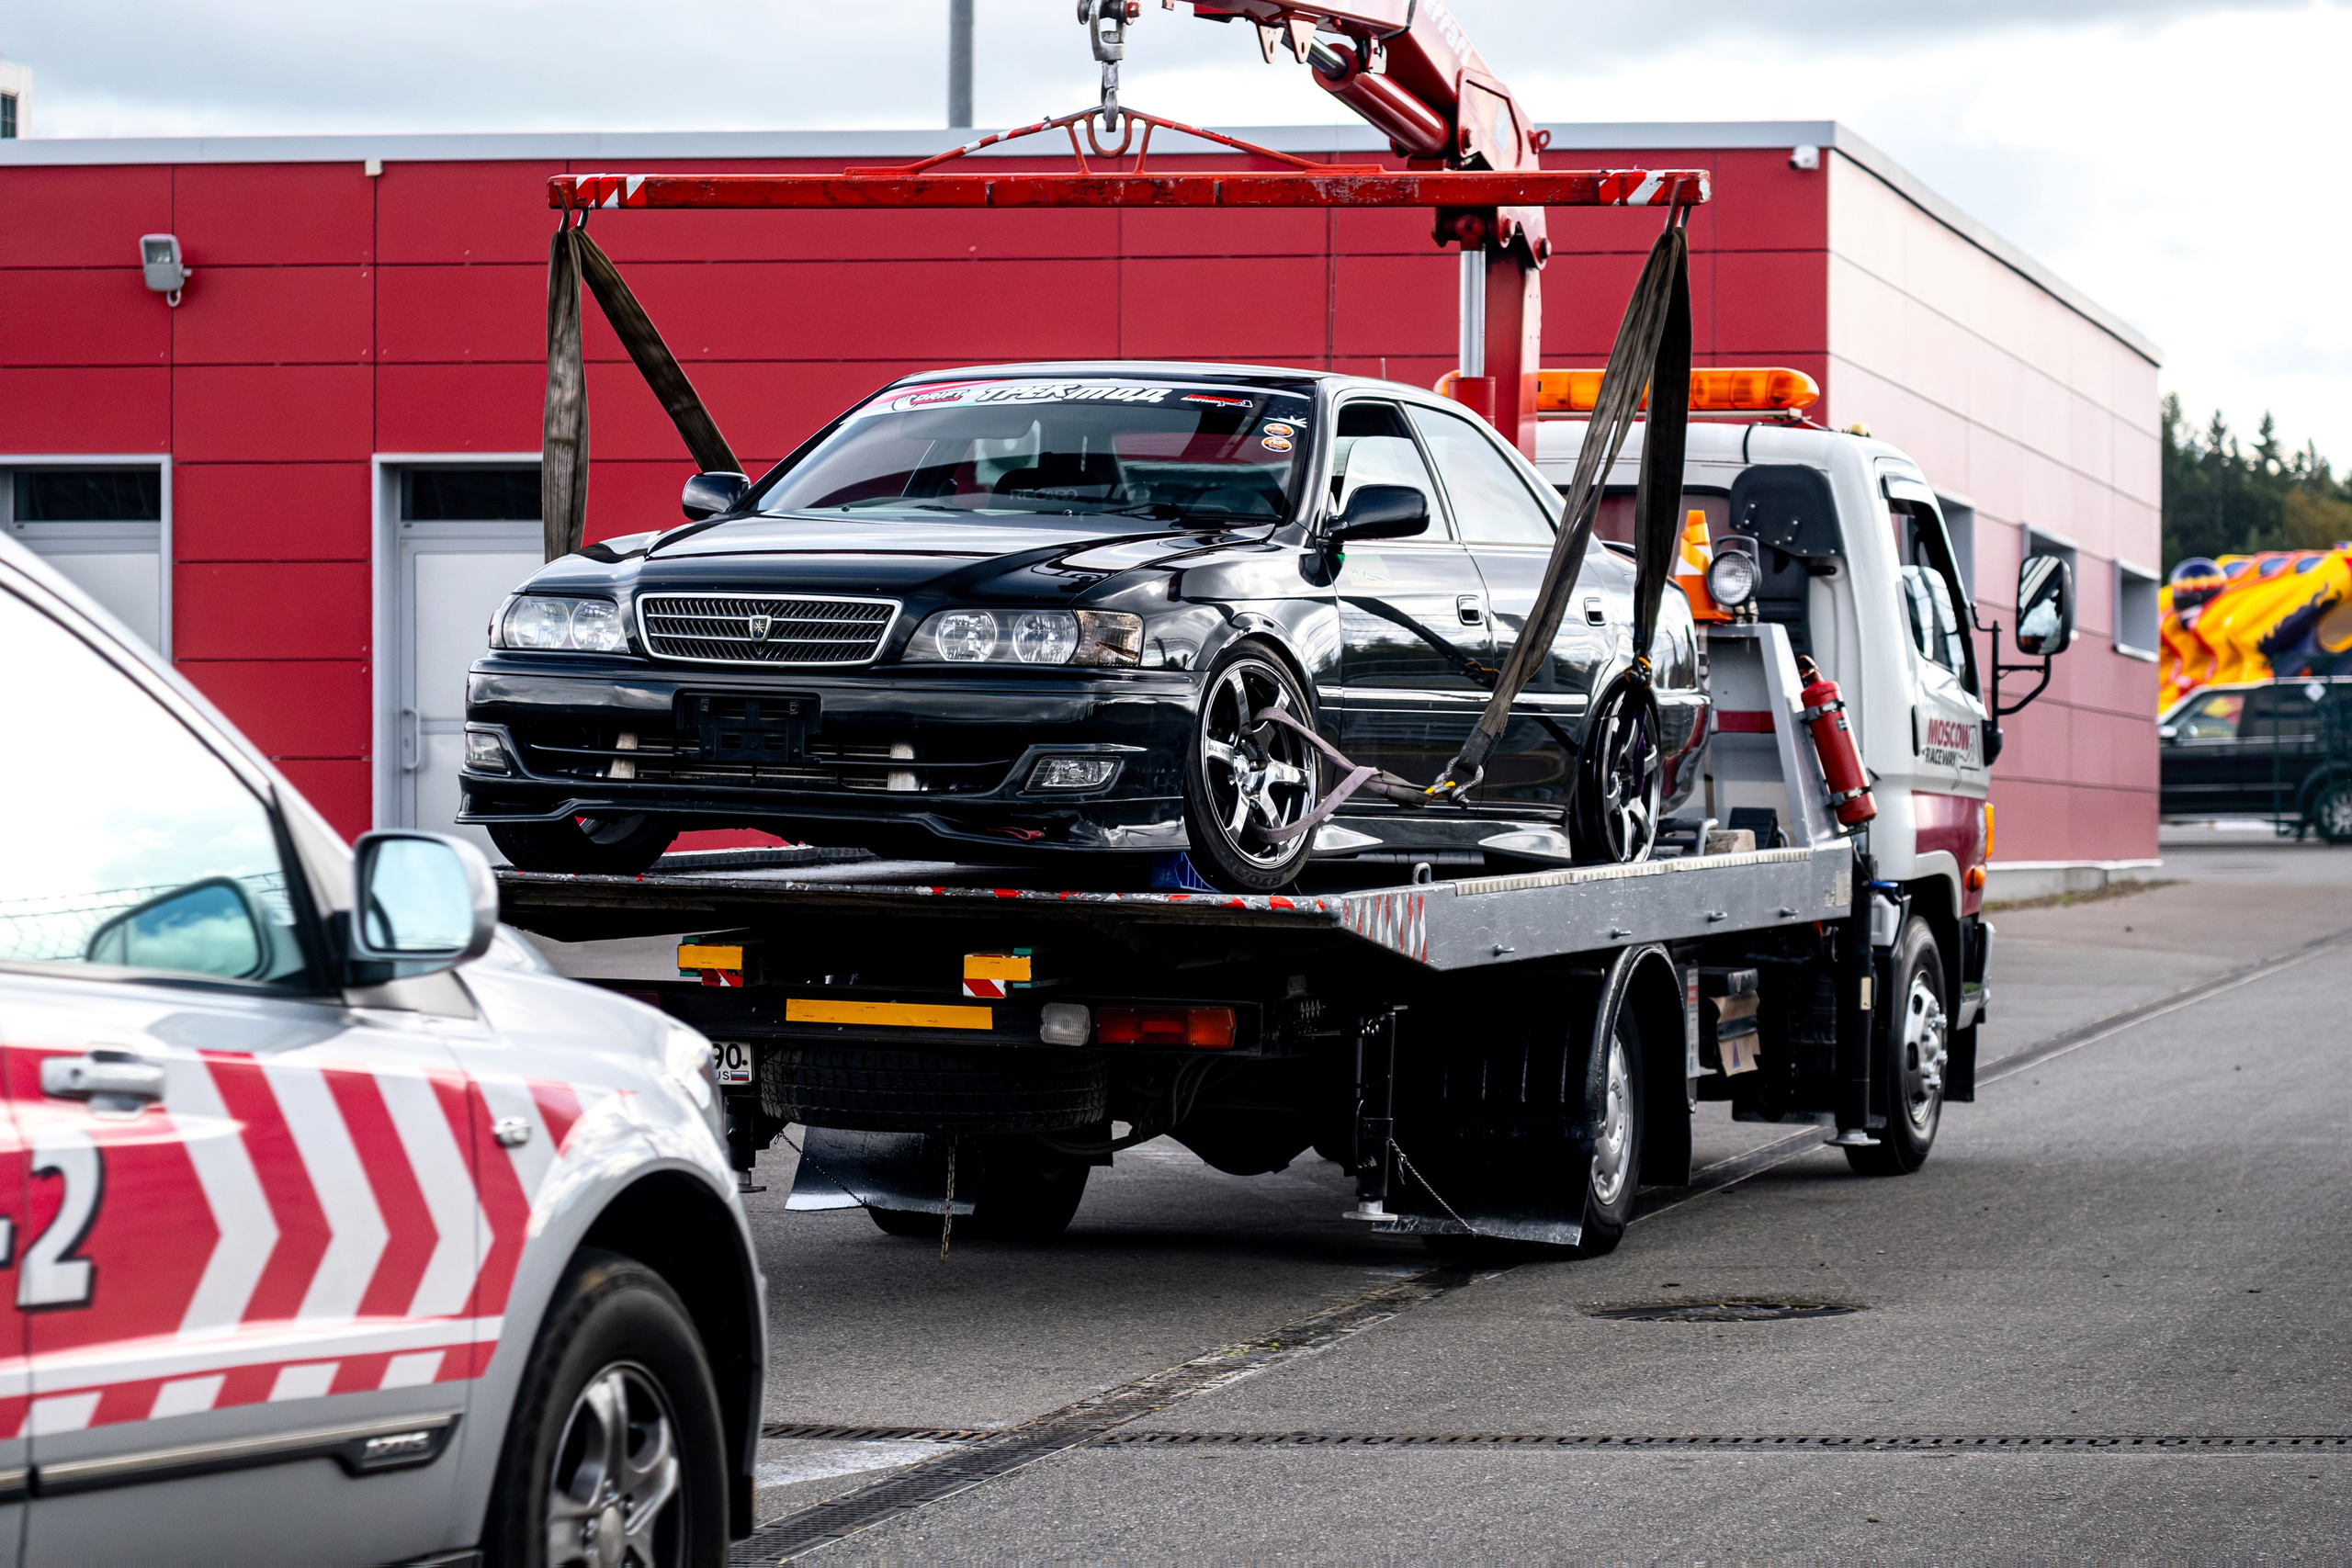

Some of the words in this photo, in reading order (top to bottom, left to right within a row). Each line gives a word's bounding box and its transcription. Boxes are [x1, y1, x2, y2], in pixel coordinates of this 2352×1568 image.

[914, 389, 971, 402] DRIFT
[1010, 489, 1079, 502] RECARO
[1928, 718, 1970, 750] MOSCOW
